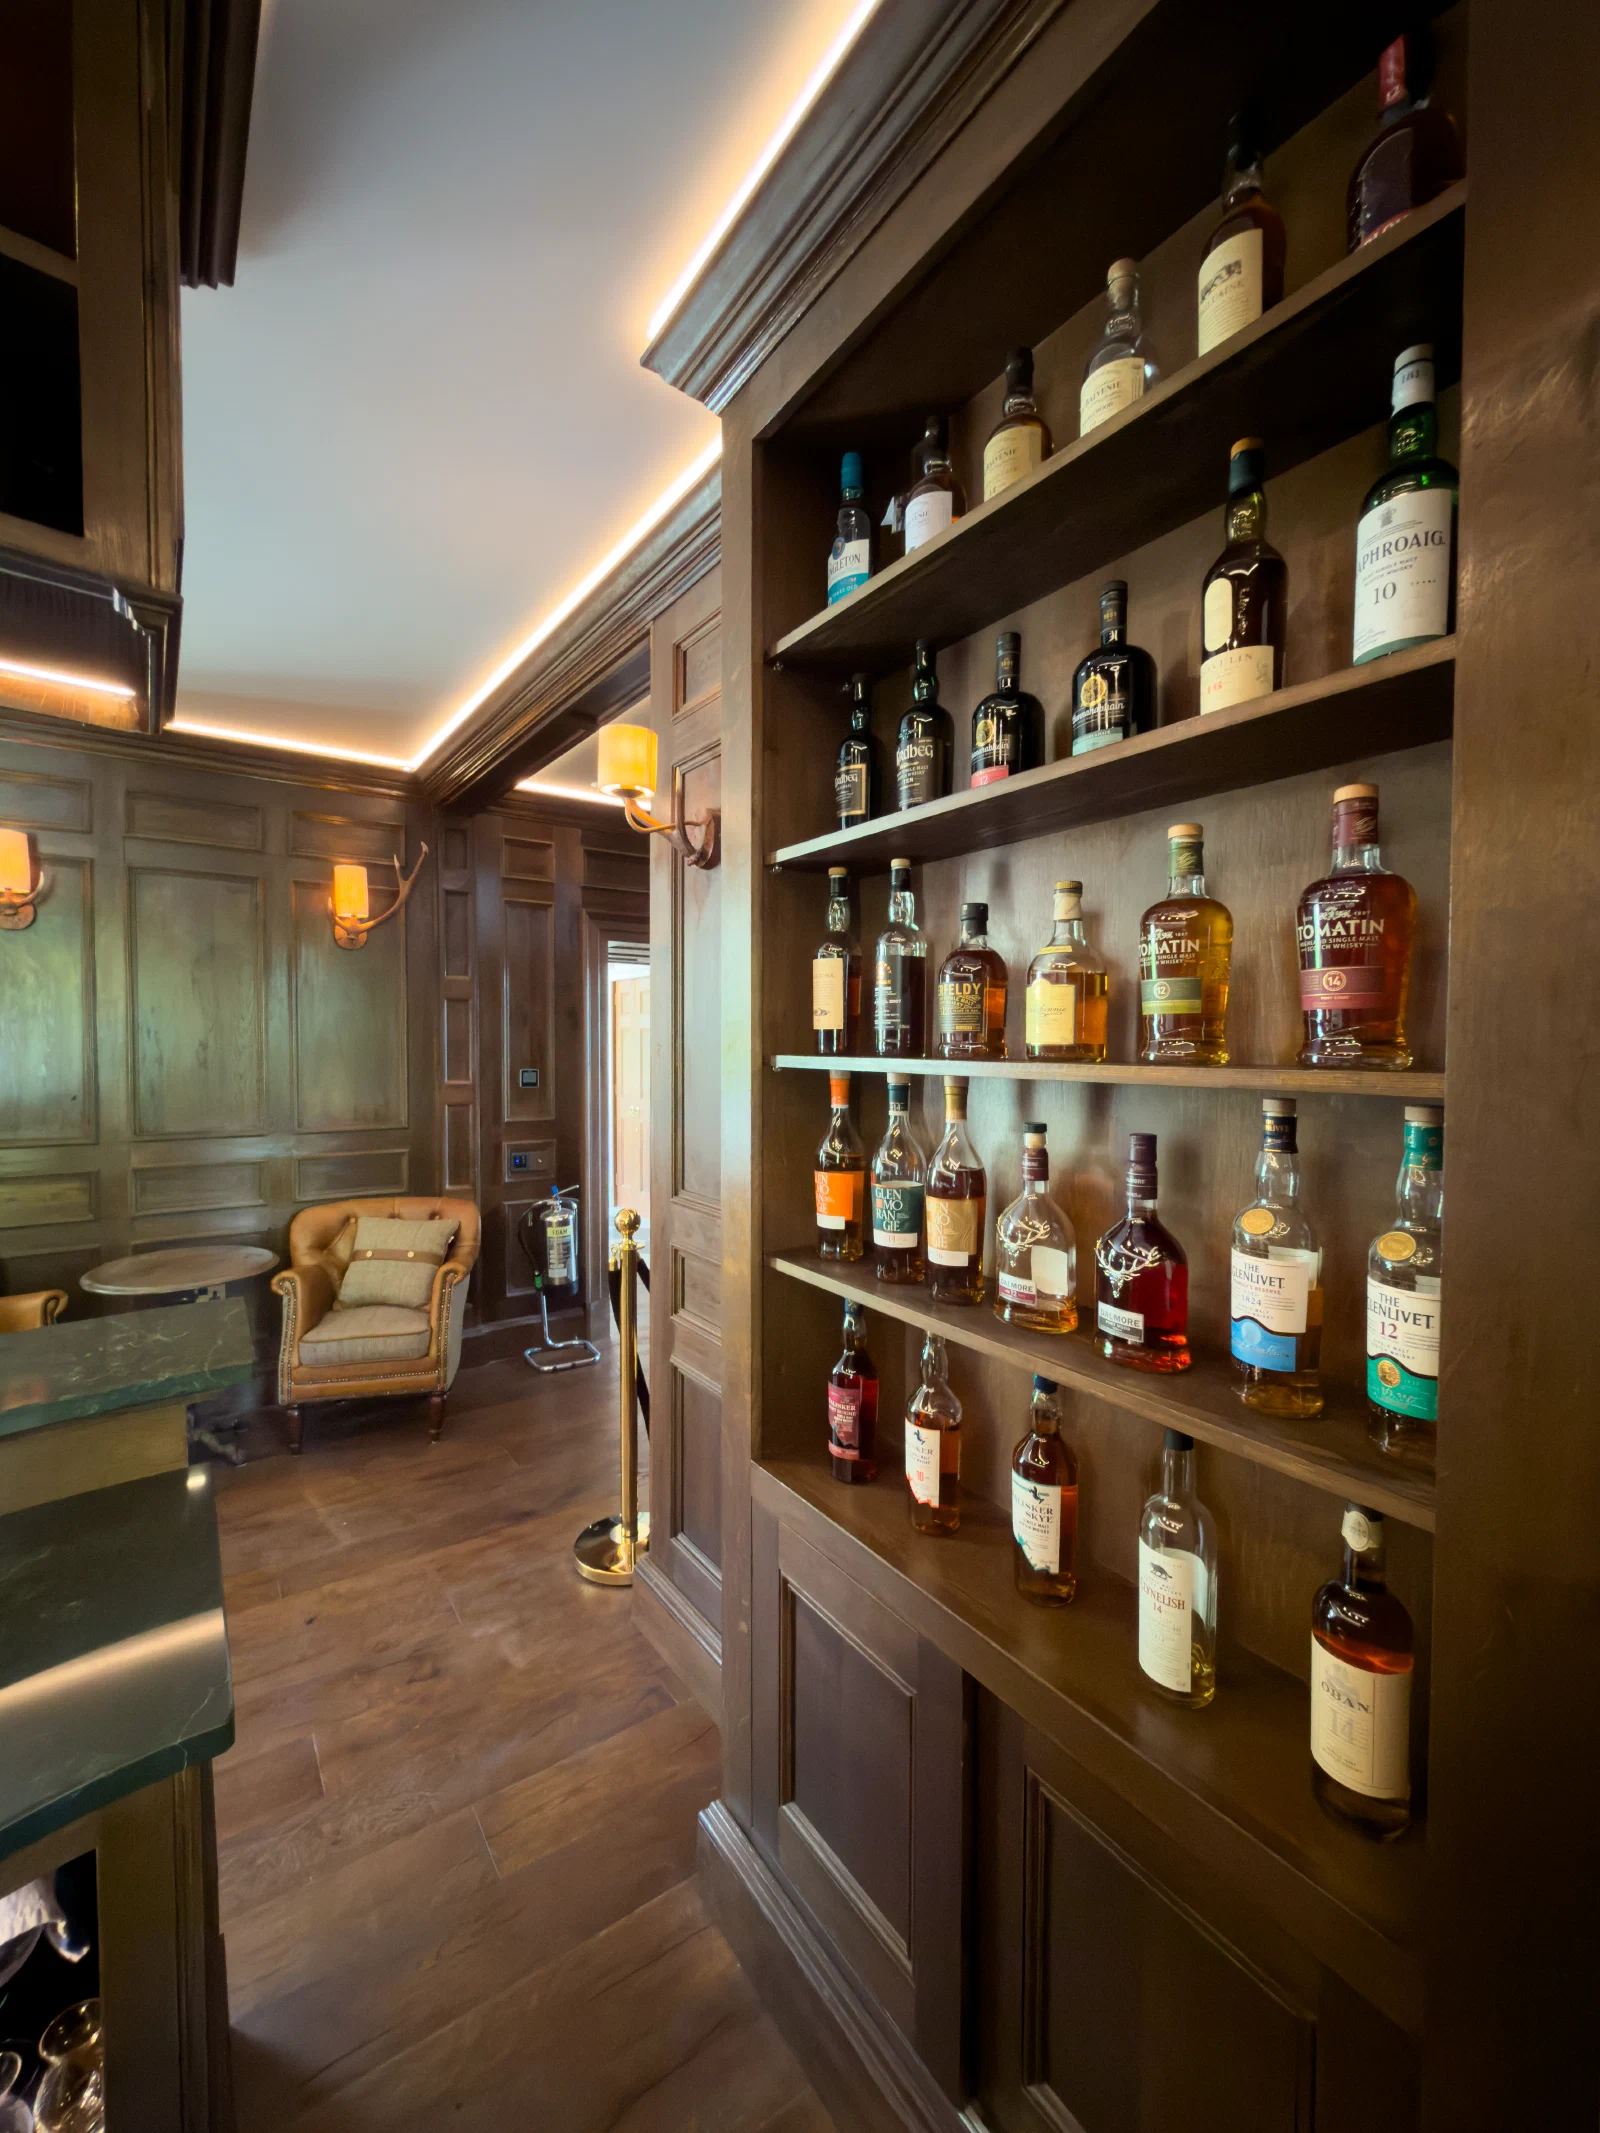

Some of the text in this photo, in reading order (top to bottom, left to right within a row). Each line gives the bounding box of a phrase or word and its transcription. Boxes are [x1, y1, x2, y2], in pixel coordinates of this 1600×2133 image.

[1374, 581, 1397, 605] 10
[980, 775, 989, 786] 12
[1297, 918, 1385, 941] TOMATIN
[1328, 935, 1356, 943] SINGLE
[1157, 952, 1178, 960] SINGLE
[1327, 976, 1341, 987] 14
[1157, 986, 1166, 995] 12
[875, 1186, 902, 1201] GLEN
[883, 1199, 904, 1211] MO
[876, 1209, 896, 1221] RAN
[882, 1219, 901, 1232] GIE
[1243, 1262, 1260, 1273] THE
[1000, 1278, 1034, 1292] DALMORE
[1241, 1294, 1262, 1306] 1824
[1379, 1292, 1400, 1308] THE
[1100, 1308, 1141, 1328] DALMORE
[1380, 1321, 1398, 1340] 12
[916, 1470, 925, 1482] 10
[1025, 1511, 1053, 1524] SKYE
[1153, 1602, 1163, 1614] 14
[1321, 1681, 1373, 1715] OBAN
